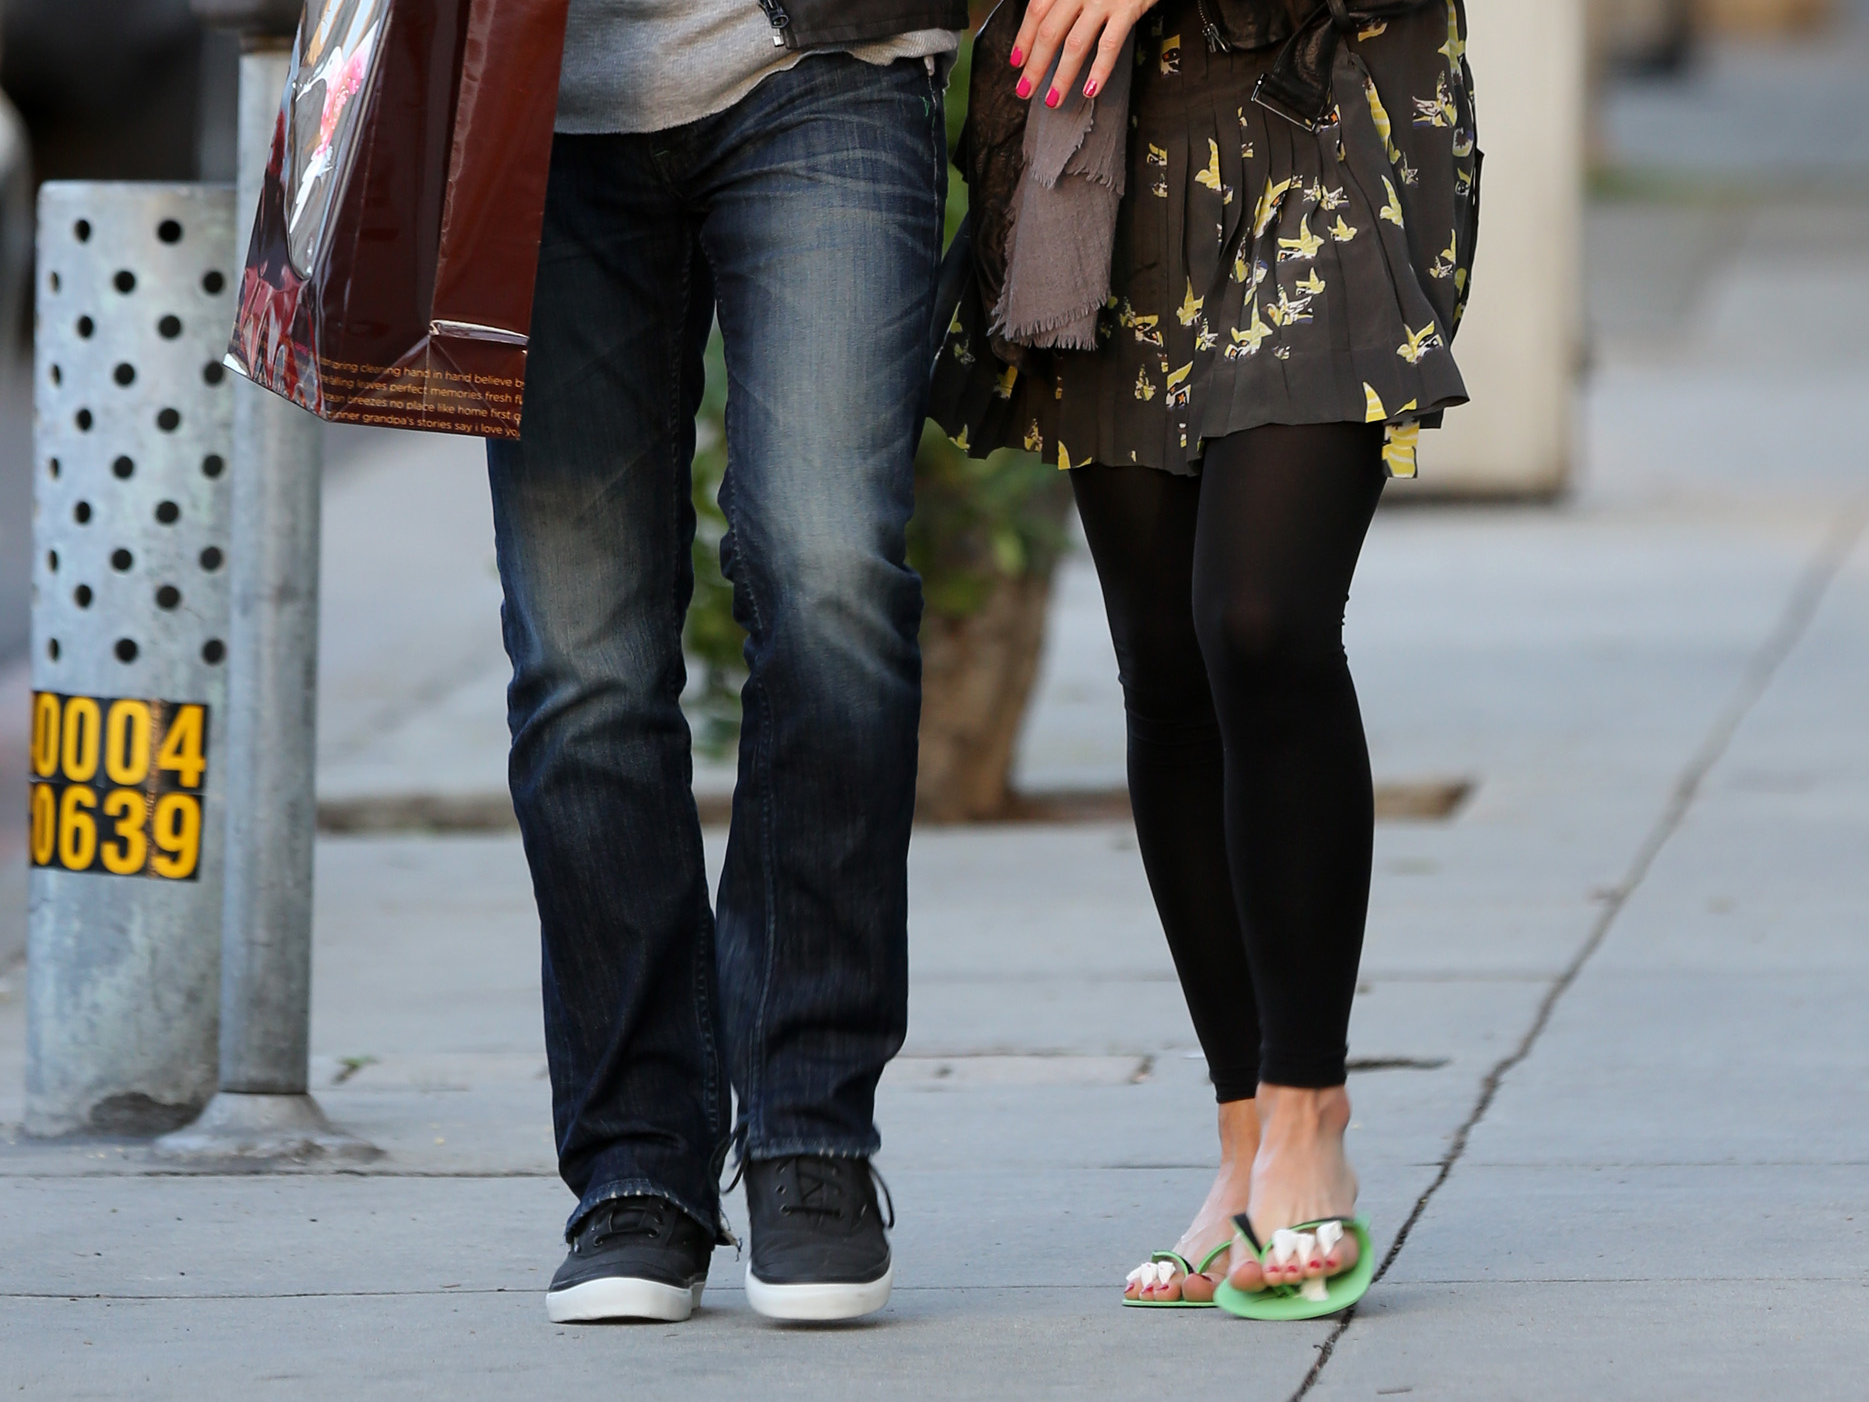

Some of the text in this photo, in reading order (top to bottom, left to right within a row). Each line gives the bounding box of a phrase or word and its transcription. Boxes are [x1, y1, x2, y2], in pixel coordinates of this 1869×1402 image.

[403, 366, 431, 379] hand
[432, 370, 443, 379] in
[445, 370, 472, 383] hand
[474, 373, 513, 387] believe
[389, 383, 428, 395] perfect
[430, 387, 482, 400] memories
[485, 391, 512, 403] fresh
[347, 395, 388, 408] breezes
[390, 400, 404, 409] no
[406, 401, 435, 413] place
[437, 403, 455, 414] like
[457, 405, 488, 417] home
[490, 408, 511, 420] first
[362, 413, 415, 426] grandpa's
[417, 418, 452, 429] stories
[454, 423, 472, 432] say
[481, 423, 503, 434] love
[32, 691, 206, 788] 0004
[31, 782, 202, 879] 0639
